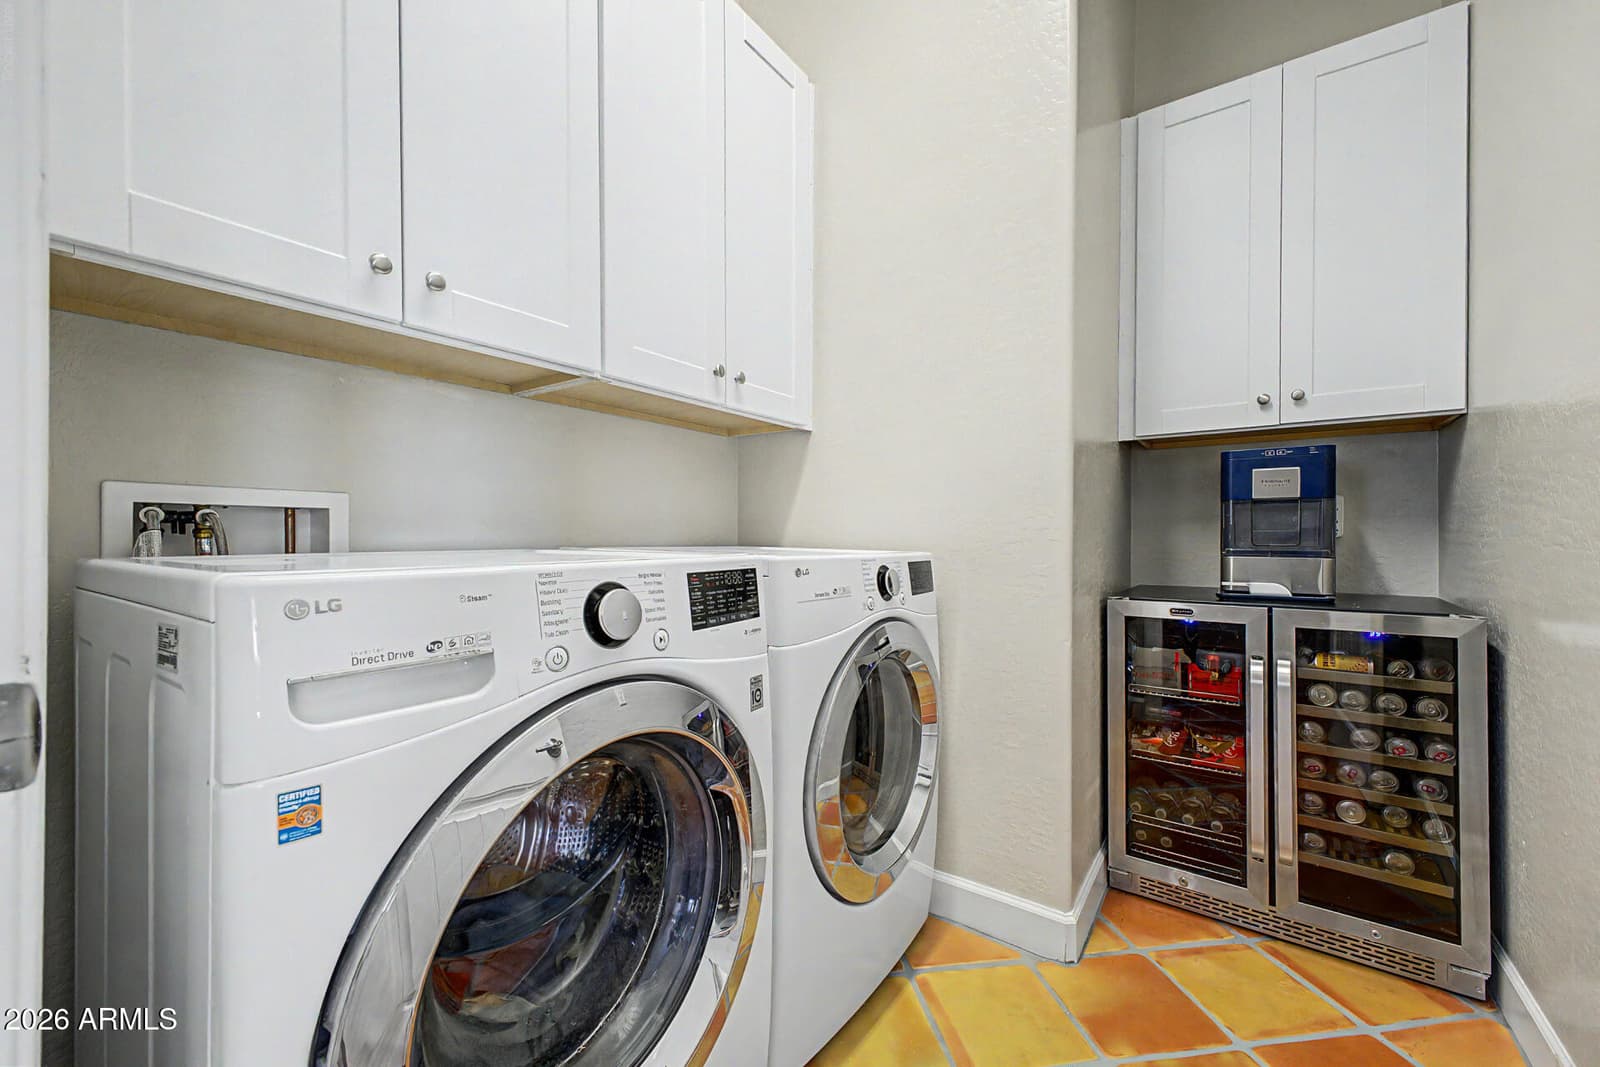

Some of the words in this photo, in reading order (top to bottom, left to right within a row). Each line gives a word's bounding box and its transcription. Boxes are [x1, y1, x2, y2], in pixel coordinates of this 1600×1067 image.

[802, 568, 811, 576] LG
[314, 598, 343, 615] LG
[351, 653, 386, 666] Direct
[387, 649, 415, 661] Drive
